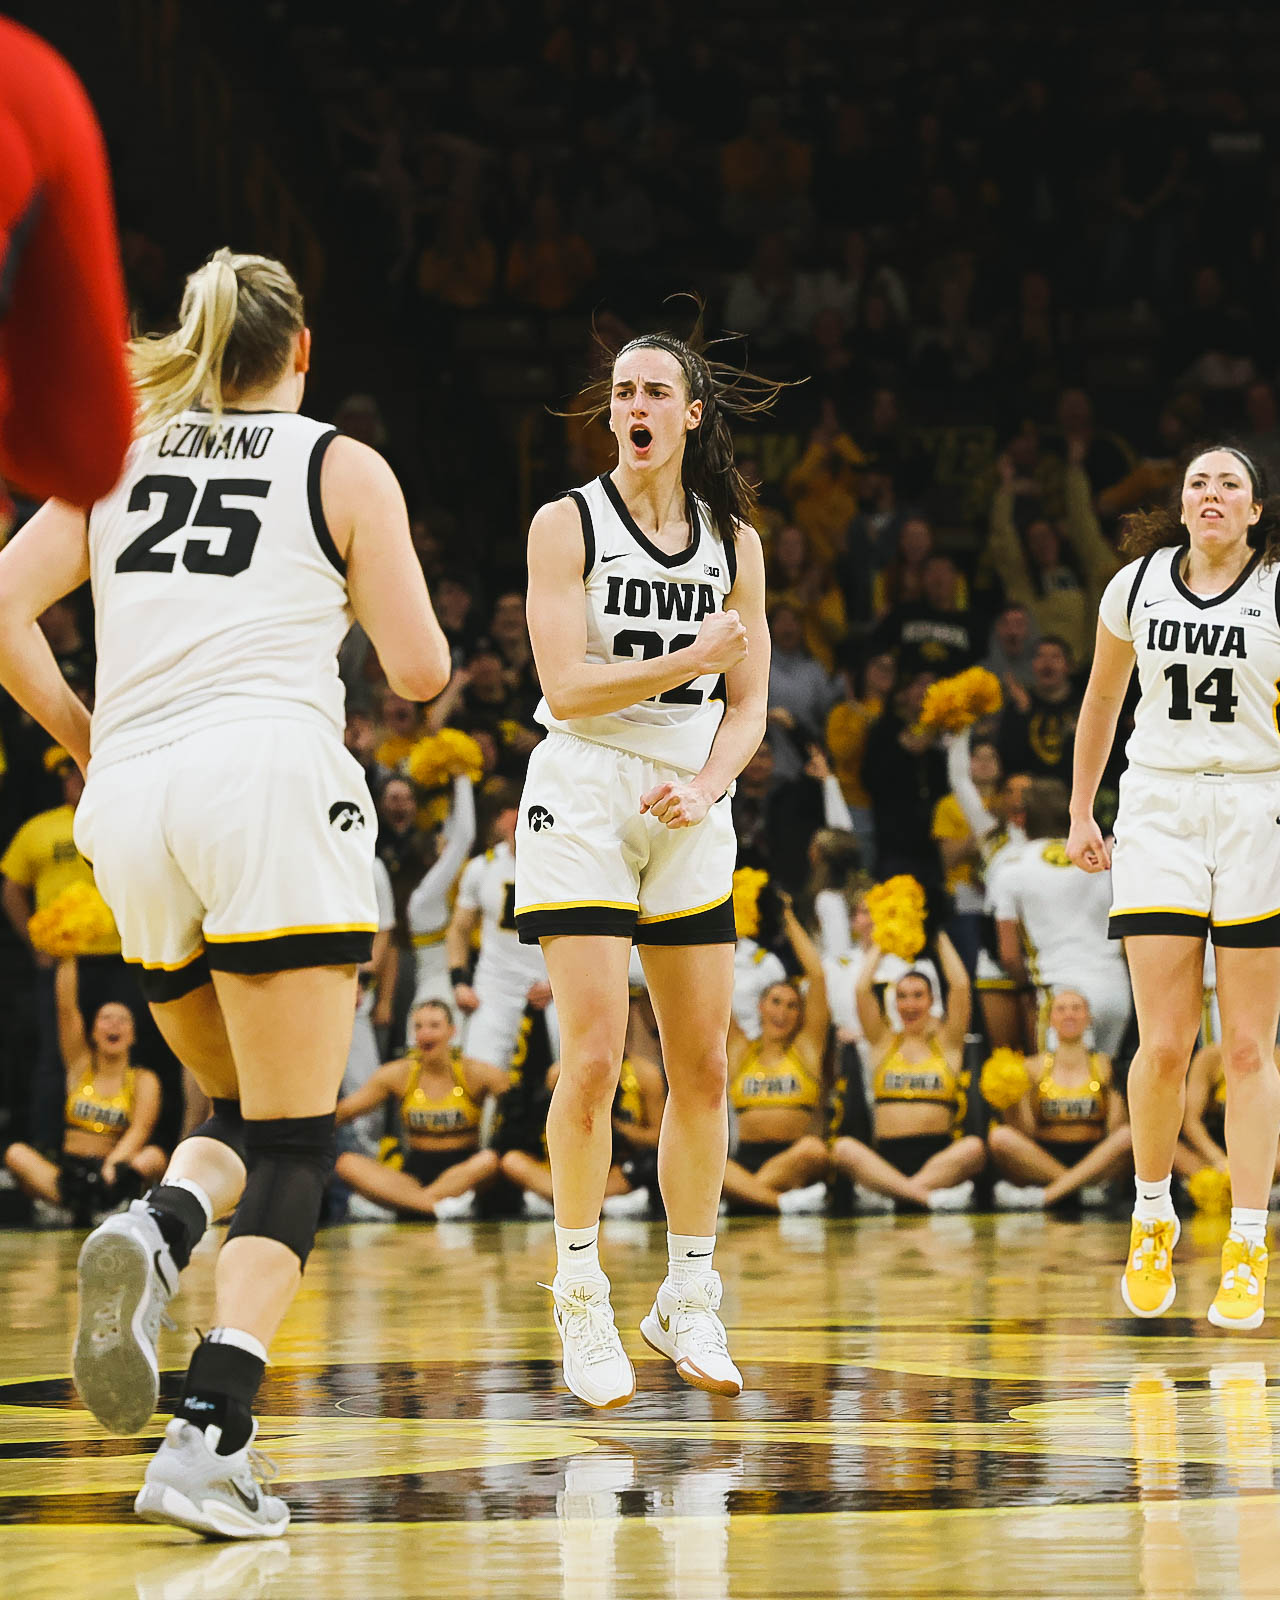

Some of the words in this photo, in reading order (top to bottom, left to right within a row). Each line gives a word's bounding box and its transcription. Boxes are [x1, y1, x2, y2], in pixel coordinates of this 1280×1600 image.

[115, 474, 272, 577] 25
[604, 576, 716, 622] IOWA
[1147, 618, 1248, 660] IOWA
[1164, 663, 1239, 723] 14
